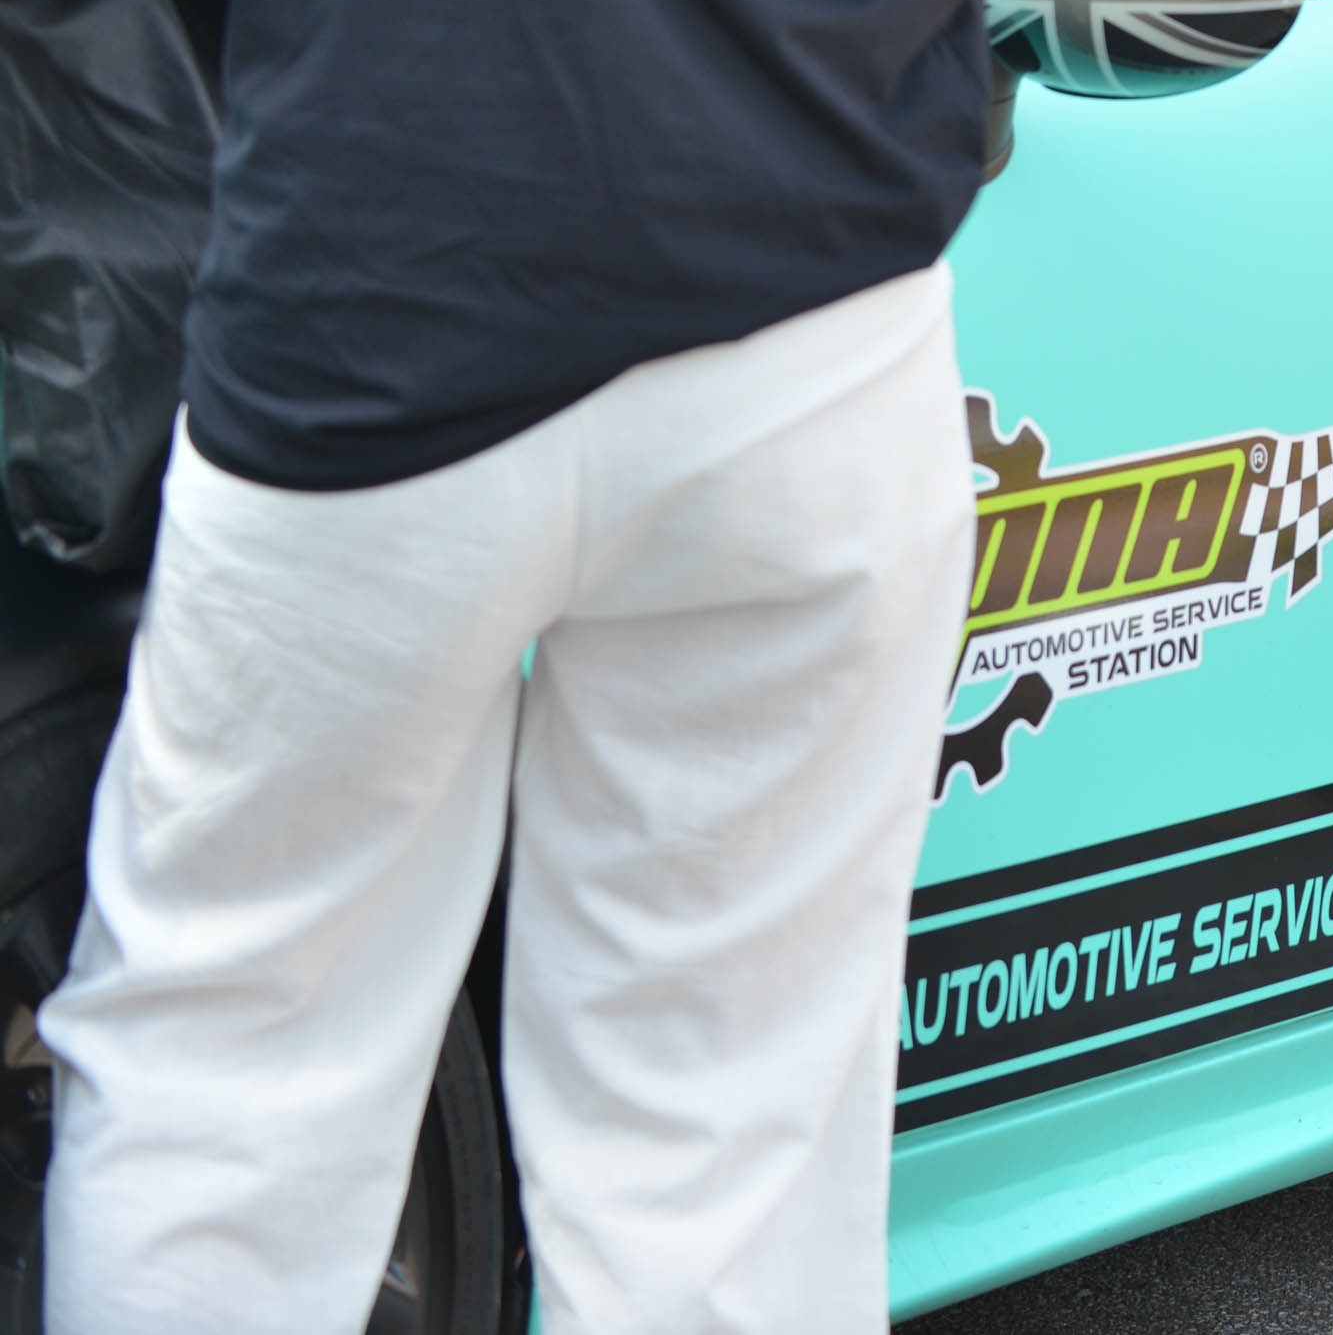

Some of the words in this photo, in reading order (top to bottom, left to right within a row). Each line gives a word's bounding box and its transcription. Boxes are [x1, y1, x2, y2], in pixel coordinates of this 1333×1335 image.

[971, 614, 1143, 675] AUTOMOTIVE
[1153, 586, 1264, 633] SERVICE
[1067, 633, 1199, 690] STATION
